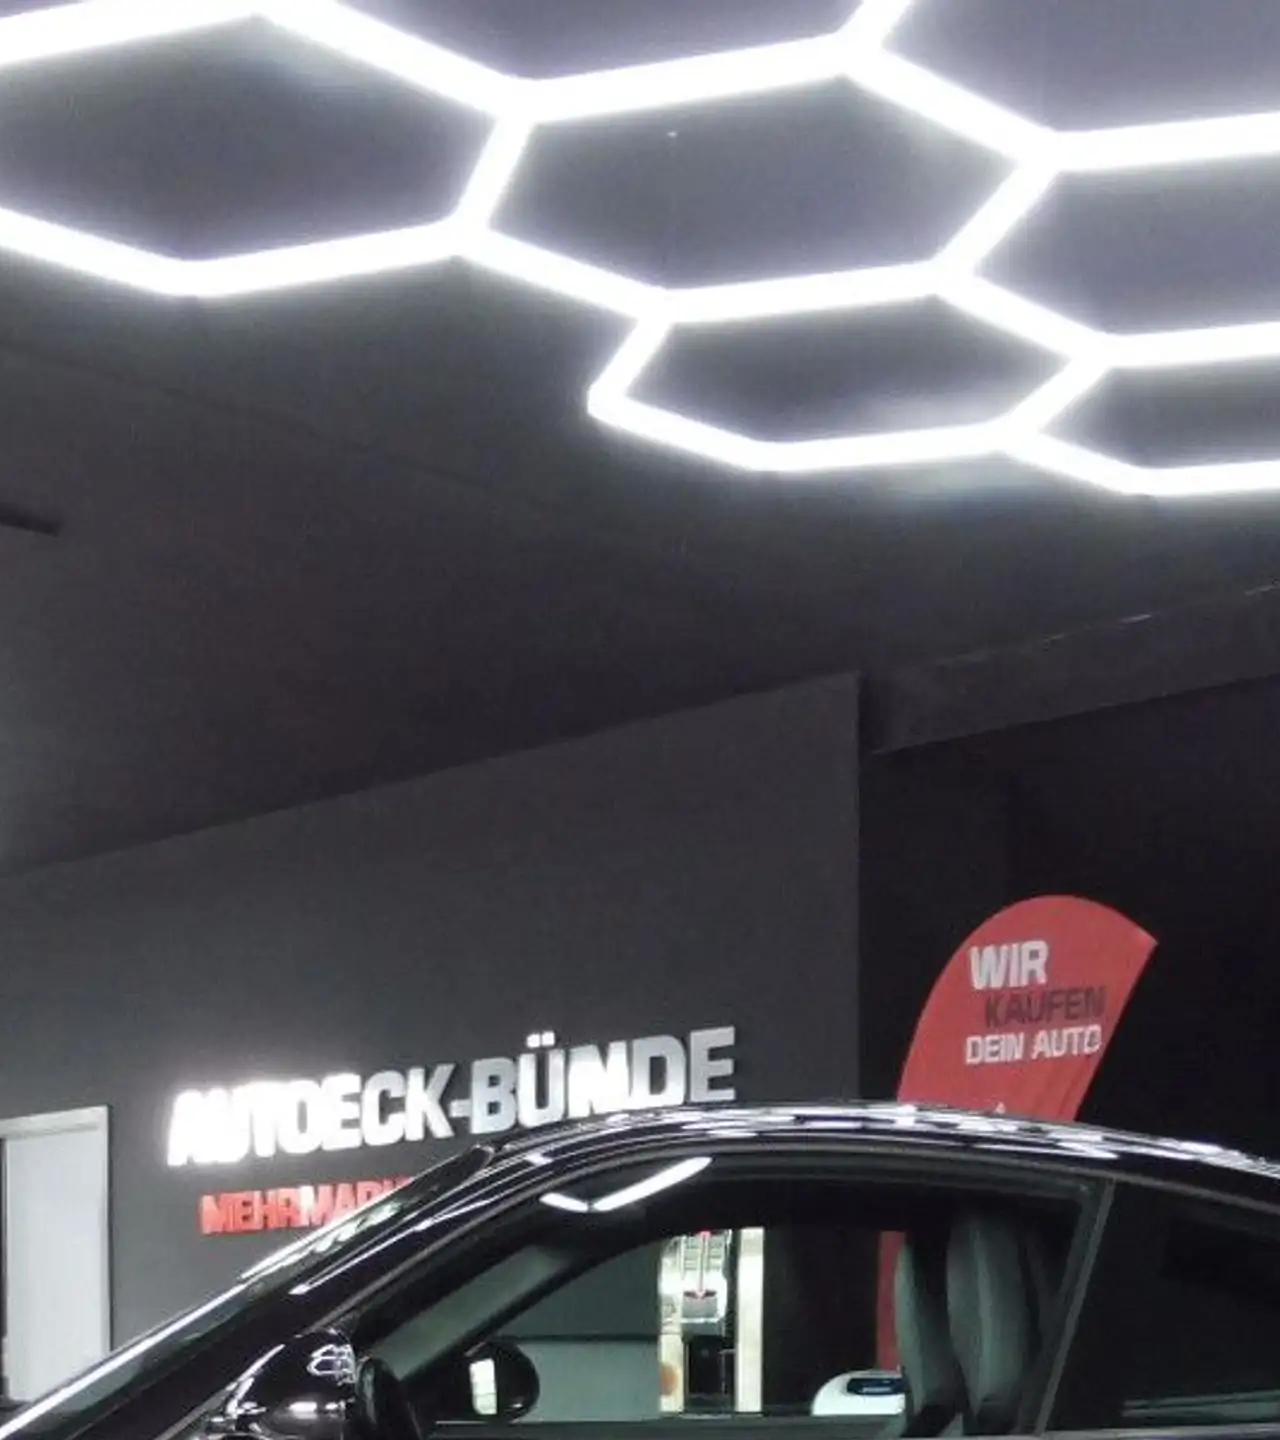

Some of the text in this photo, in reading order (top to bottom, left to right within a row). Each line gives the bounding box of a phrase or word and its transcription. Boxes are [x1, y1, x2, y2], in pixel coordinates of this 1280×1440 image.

[969, 940, 1049, 990] WIR
[985, 986, 1105, 1027] KAUFEN
[965, 1024, 1102, 1065] DEIN AUTO
